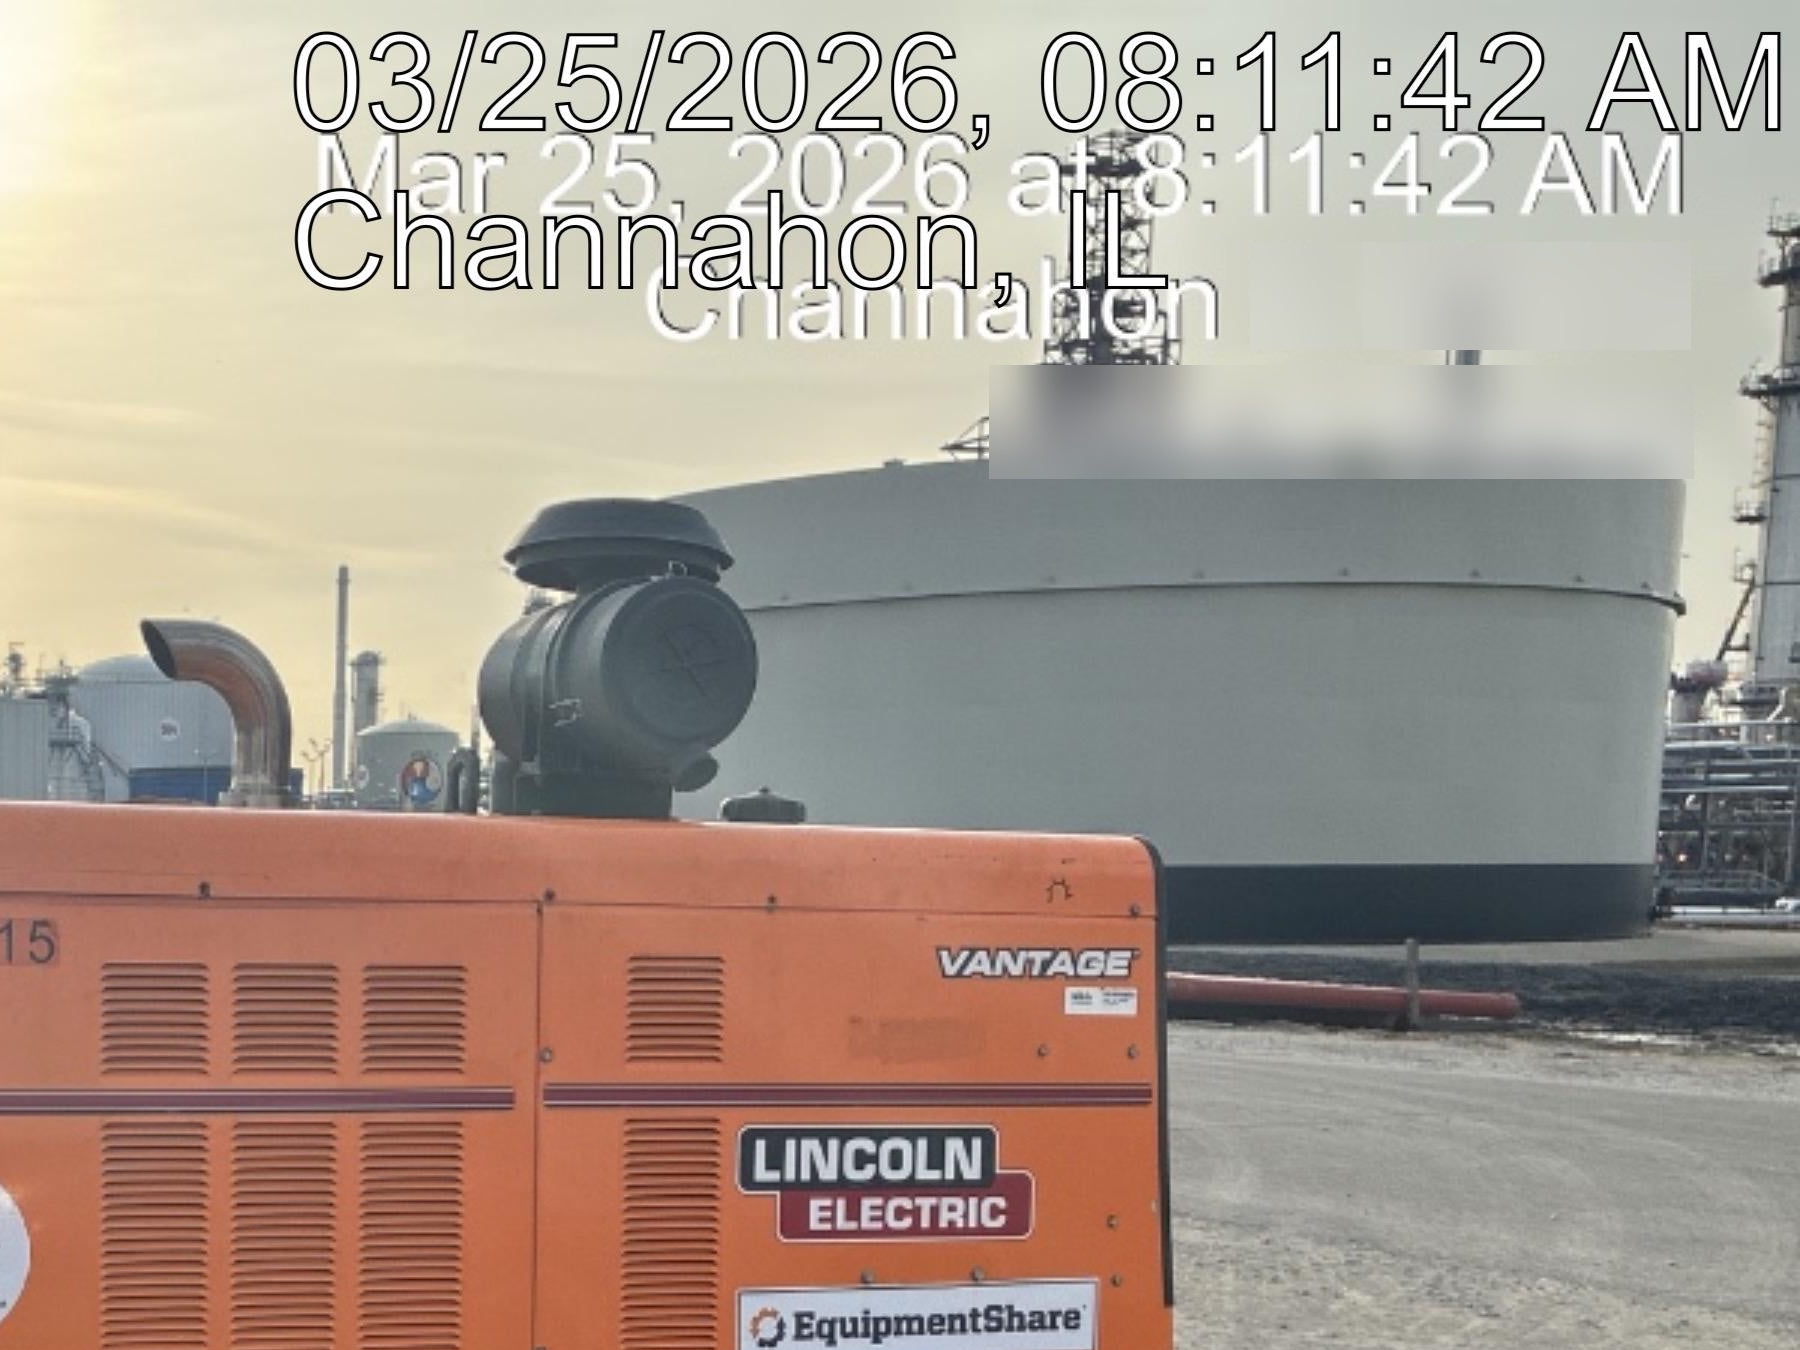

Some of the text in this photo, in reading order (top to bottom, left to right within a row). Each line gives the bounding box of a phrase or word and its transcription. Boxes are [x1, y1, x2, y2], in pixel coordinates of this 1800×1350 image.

[938, 948, 1134, 978] VANTAGE
[753, 1136, 982, 1183] LINCOLN
[809, 1196, 1007, 1231] ELECTRIC
[792, 1304, 1082, 1347] EquipmentShare
